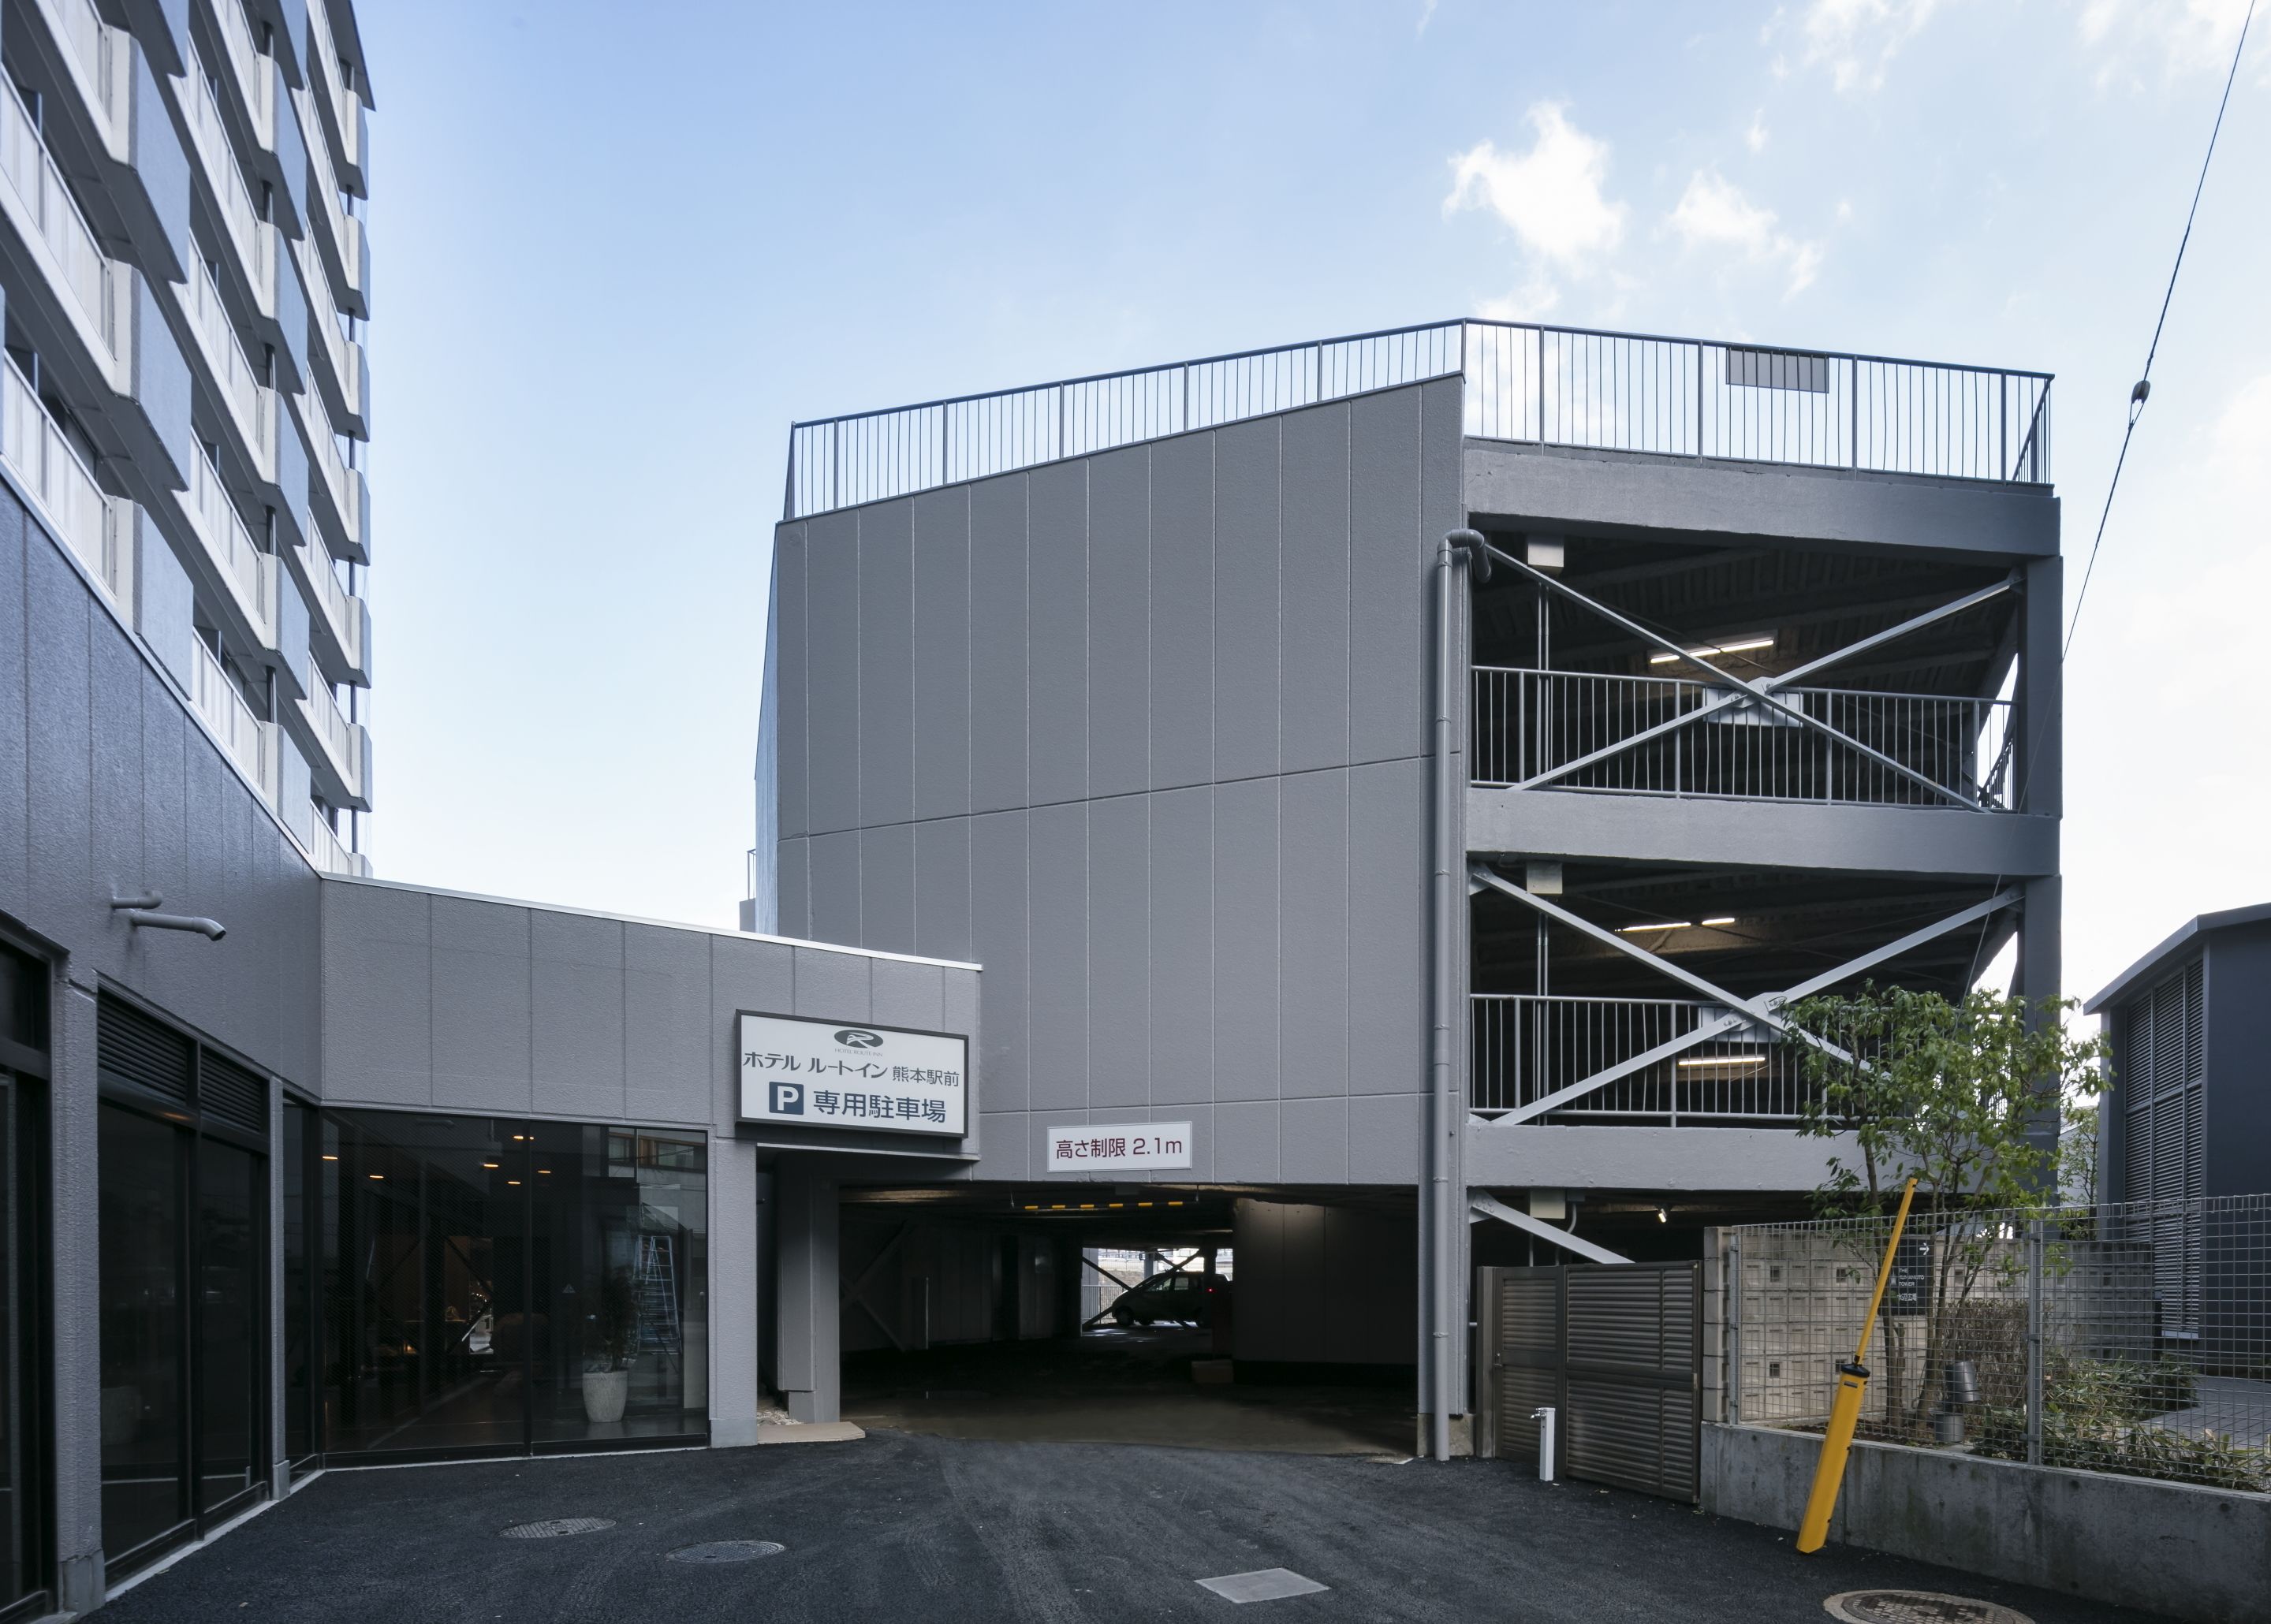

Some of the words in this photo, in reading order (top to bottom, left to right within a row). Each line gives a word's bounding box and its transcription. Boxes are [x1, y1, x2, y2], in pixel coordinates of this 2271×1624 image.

[743, 1051, 801, 1071] ホテル
[807, 1057, 888, 1078] ルートイン
[892, 1065, 960, 1087] 熊本駅前
[778, 1086, 799, 1111] P
[813, 1089, 947, 1123] 専用駐車場
[1056, 1138, 1126, 1160] 高さ制限
[1132, 1137, 1183, 1155] 2.1m
